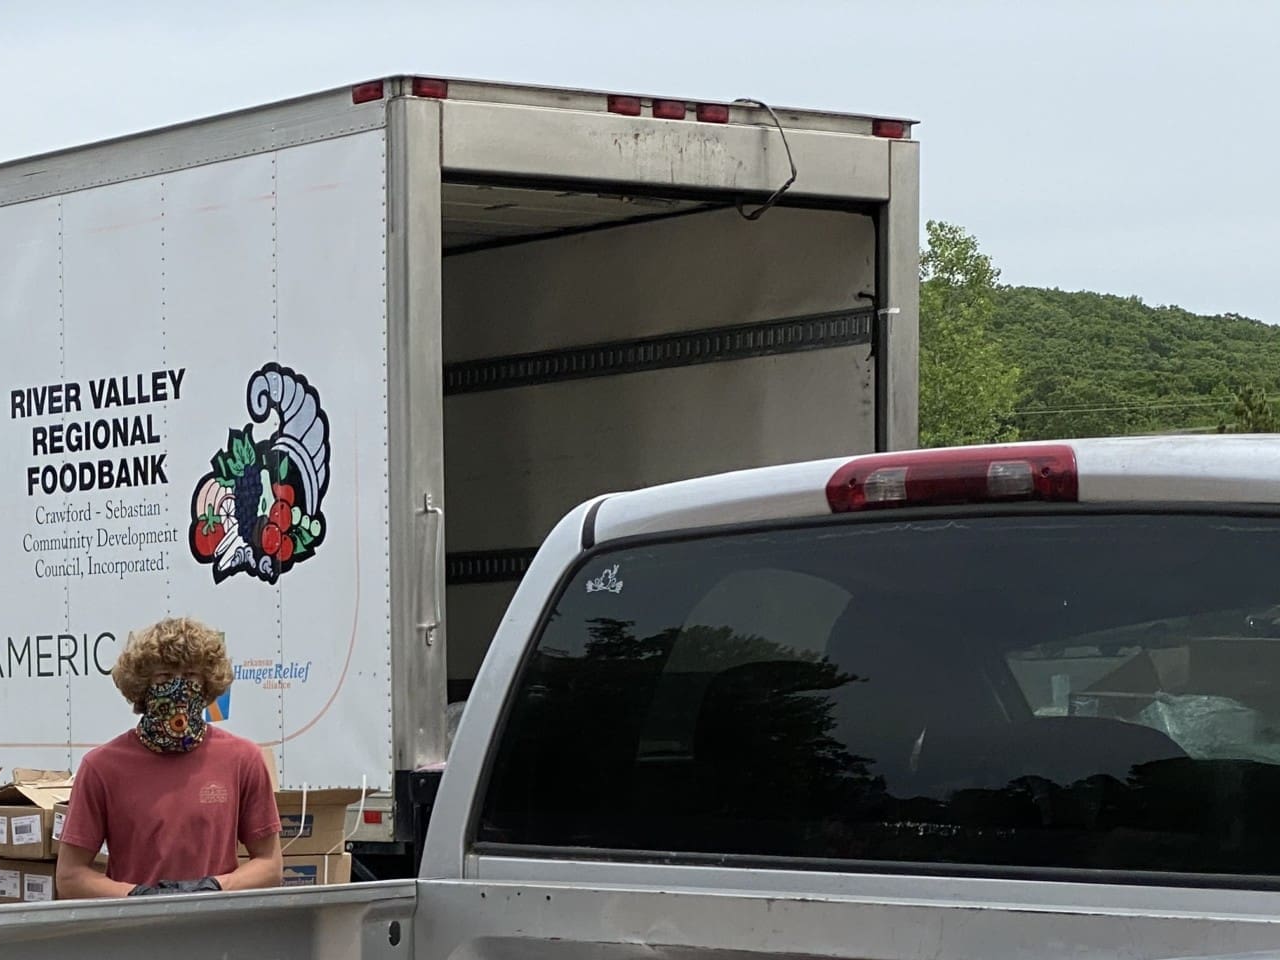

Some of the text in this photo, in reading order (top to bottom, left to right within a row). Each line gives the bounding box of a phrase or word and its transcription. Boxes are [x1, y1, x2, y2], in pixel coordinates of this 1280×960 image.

[10, 368, 186, 418] RIVER VALLEY
[32, 414, 160, 456] REGIONAL
[27, 454, 168, 496] FOODBANK
[35, 501, 92, 525] Crawford
[105, 498, 161, 519] Sebastian
[23, 527, 178, 554] Community Development
[35, 551, 165, 580] Council, Incorporated
